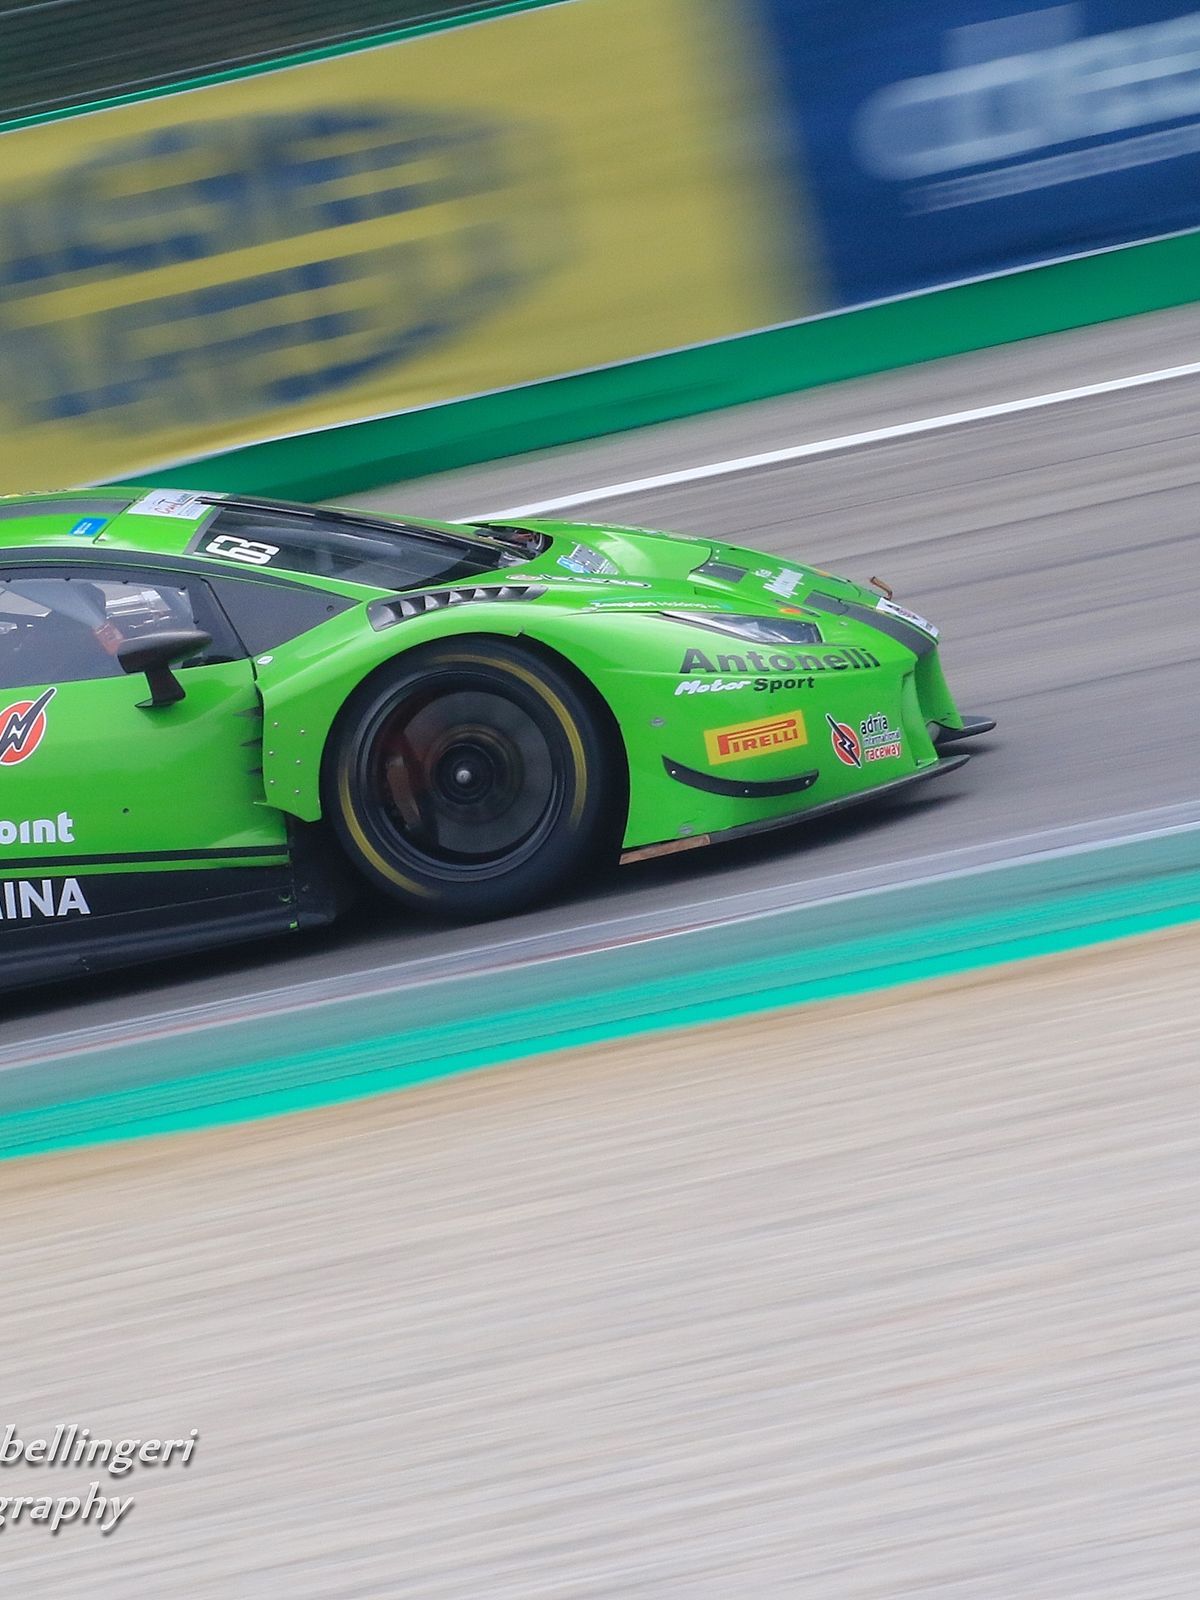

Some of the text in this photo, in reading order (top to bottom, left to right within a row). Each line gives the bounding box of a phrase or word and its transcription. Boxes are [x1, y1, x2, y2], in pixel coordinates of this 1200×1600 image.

[206, 534, 280, 565] 63
[679, 648, 881, 674] Antonelli
[674, 676, 815, 696] Motor Sport
[860, 712, 888, 736] adria
[717, 718, 799, 757] PIRELLI
[865, 742, 901, 762] raceway
